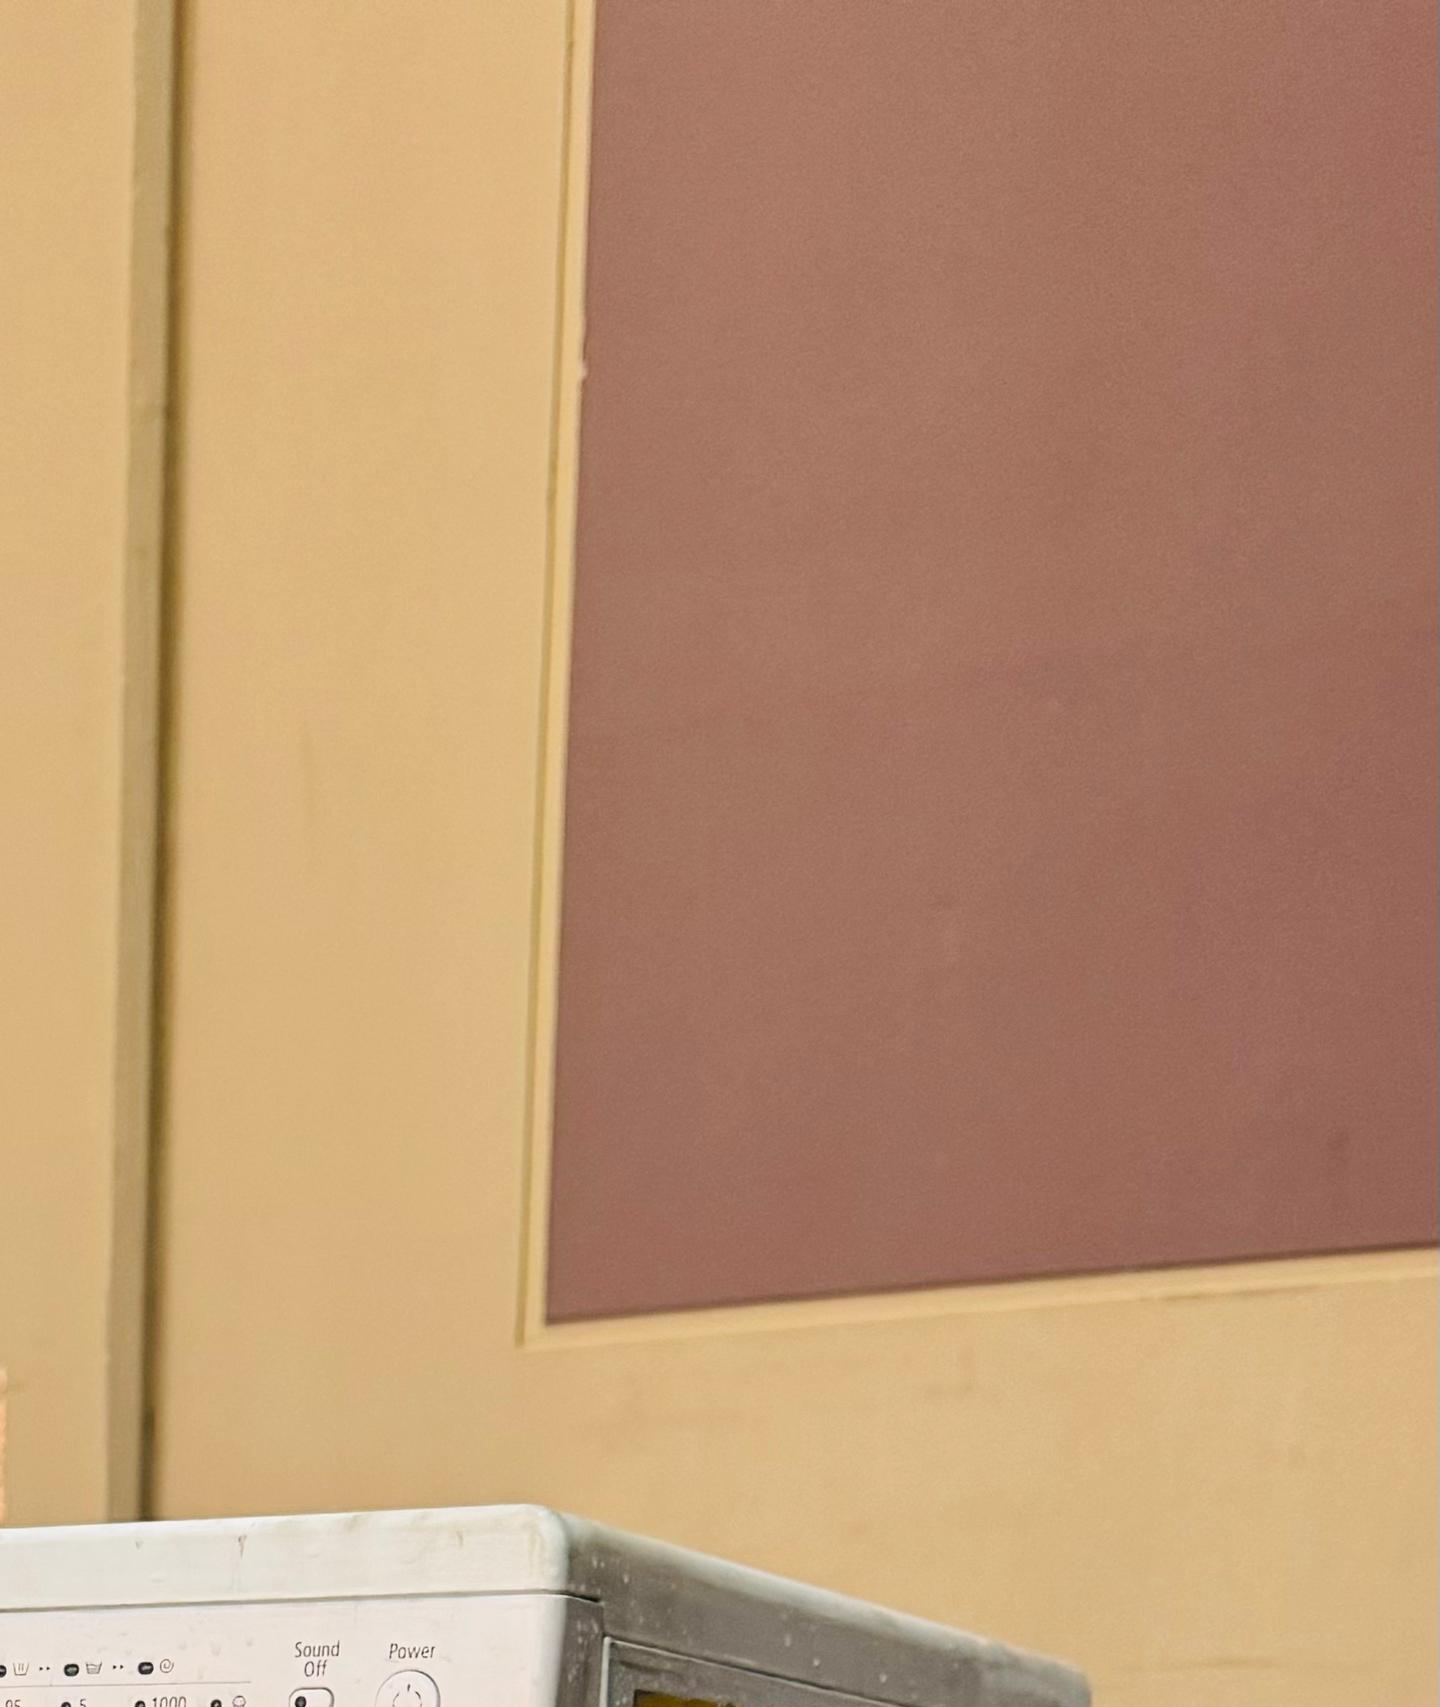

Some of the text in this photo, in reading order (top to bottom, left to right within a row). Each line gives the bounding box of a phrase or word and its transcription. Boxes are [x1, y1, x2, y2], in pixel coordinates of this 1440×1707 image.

[294, 1640, 341, 1658] Sound
[388, 1643, 436, 1660] Power
[303, 1660, 328, 1677] Off
